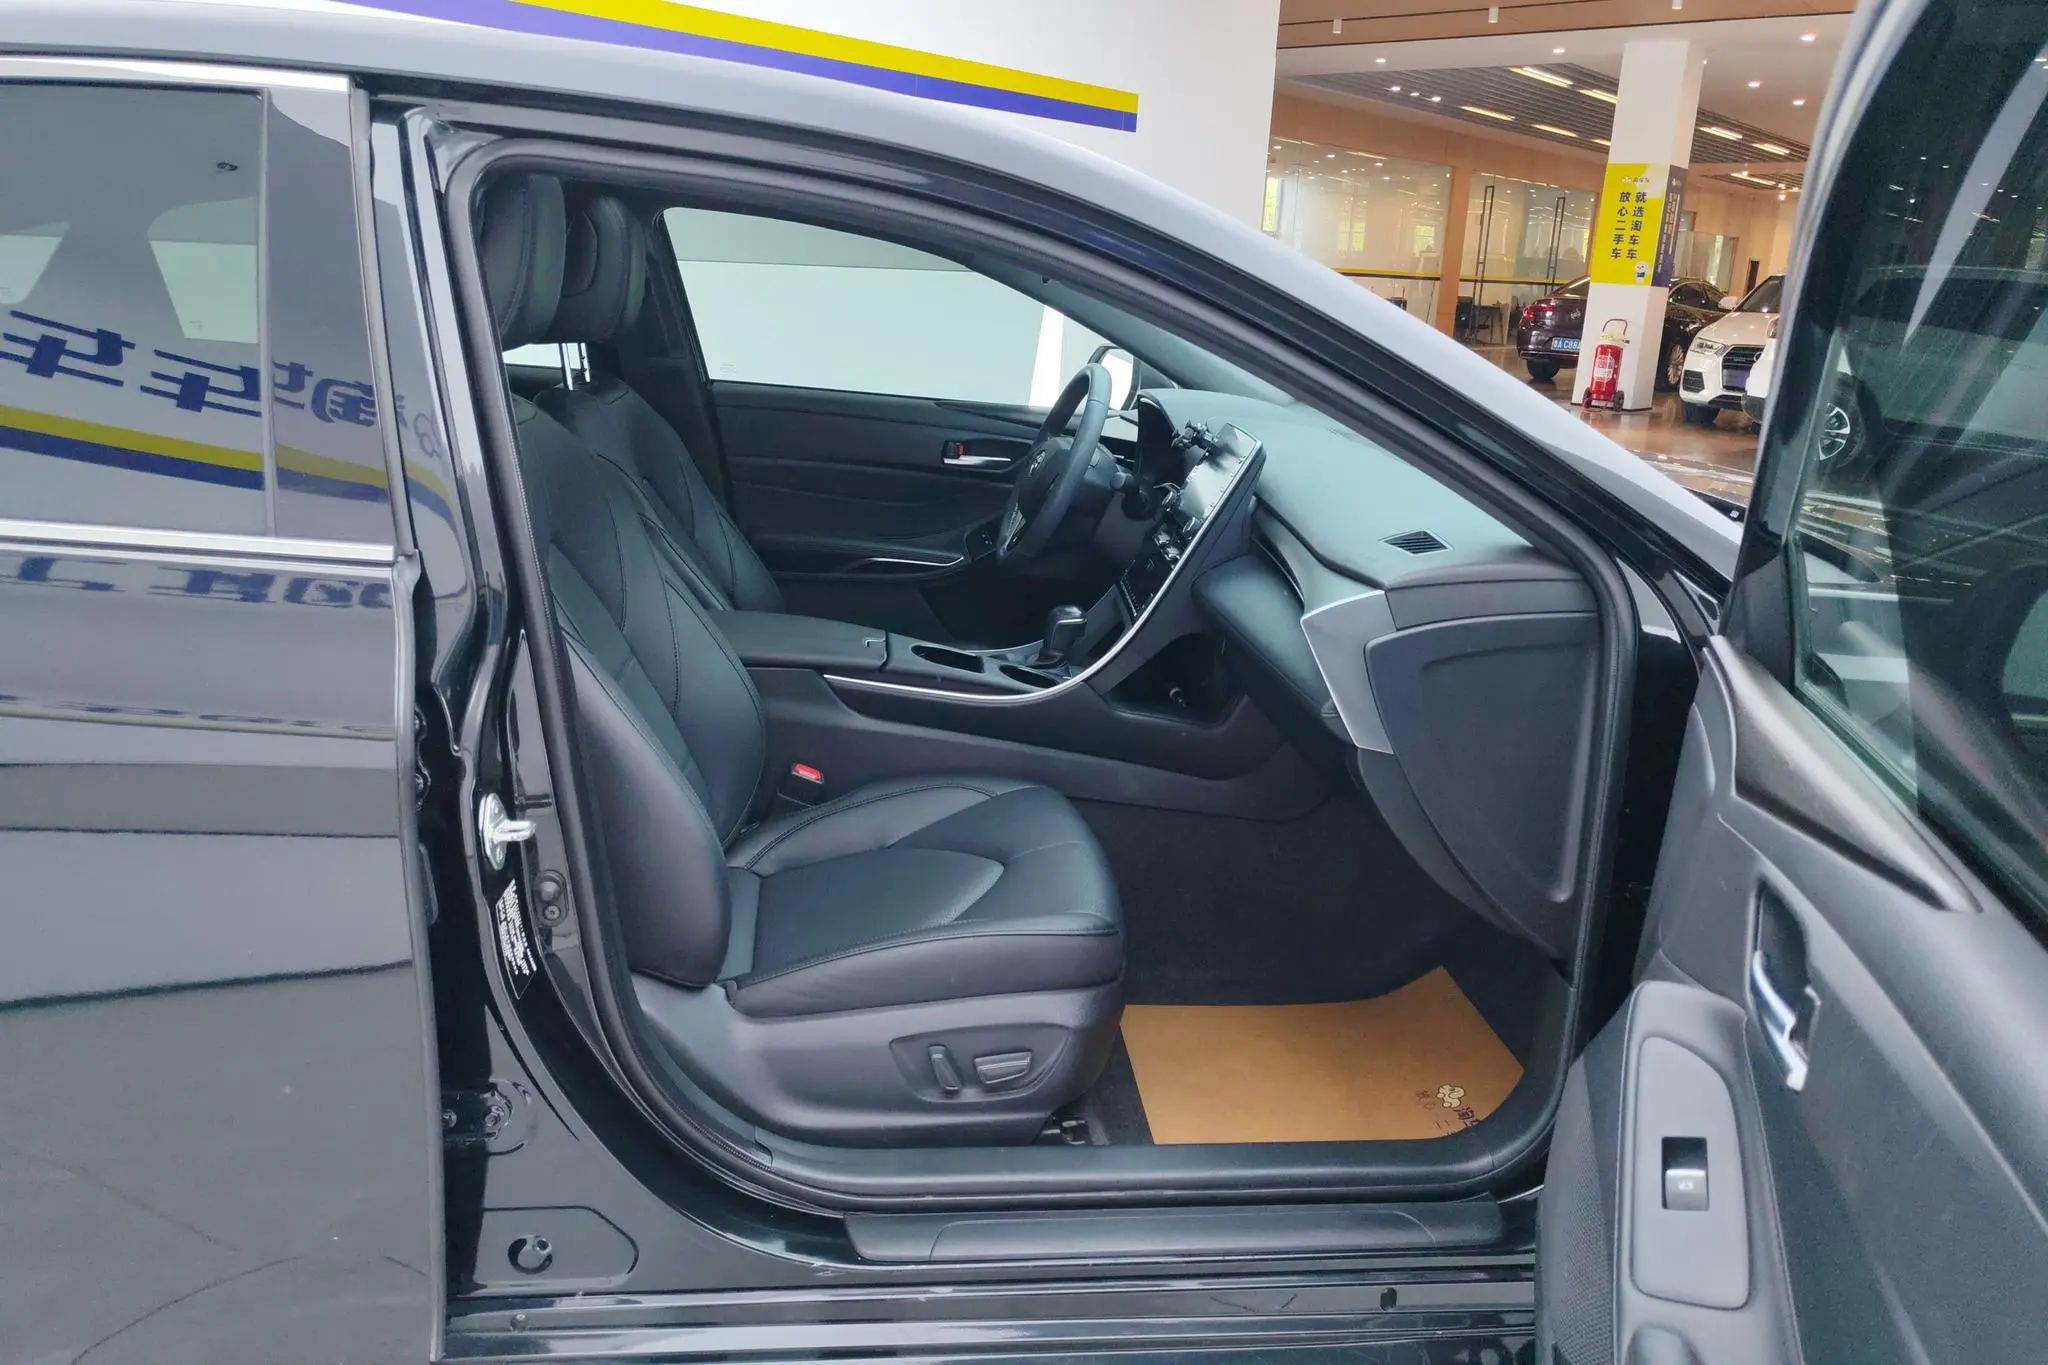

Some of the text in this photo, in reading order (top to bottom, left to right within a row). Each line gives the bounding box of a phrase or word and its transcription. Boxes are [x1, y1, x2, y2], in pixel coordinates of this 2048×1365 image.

[1610, 191, 1632, 260] 放心二手车
[1625, 191, 1648, 260] 就选淘车车
